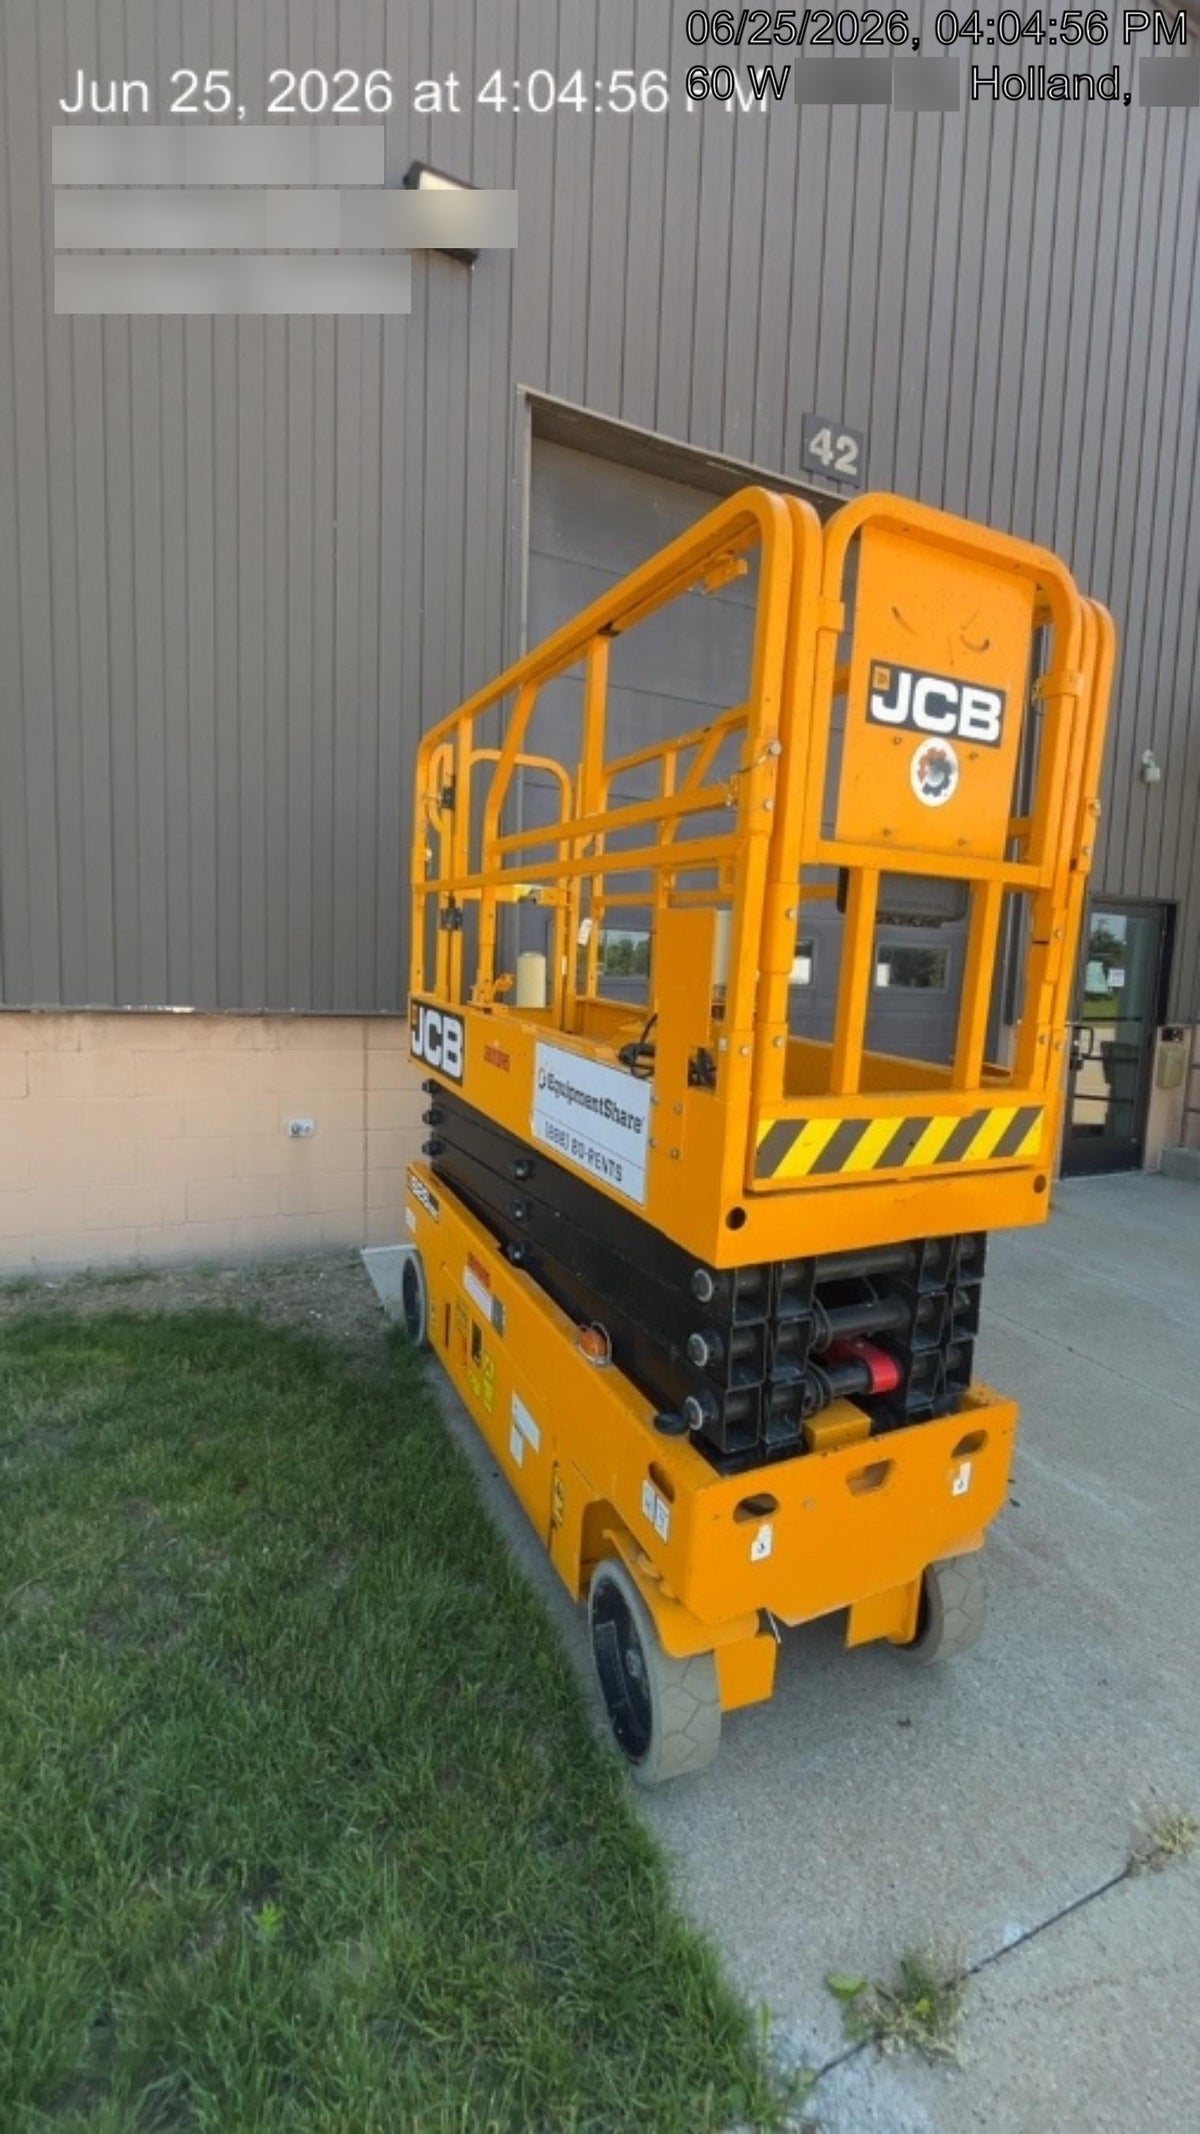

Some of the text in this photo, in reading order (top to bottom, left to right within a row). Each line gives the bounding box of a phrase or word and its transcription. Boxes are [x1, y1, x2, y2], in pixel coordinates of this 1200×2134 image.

[809, 427, 858, 475] 42
[870, 670, 1002, 743] JCB
[410, 1004, 464, 1079] JCB
[546, 1072, 643, 1135] EquipmentShare
